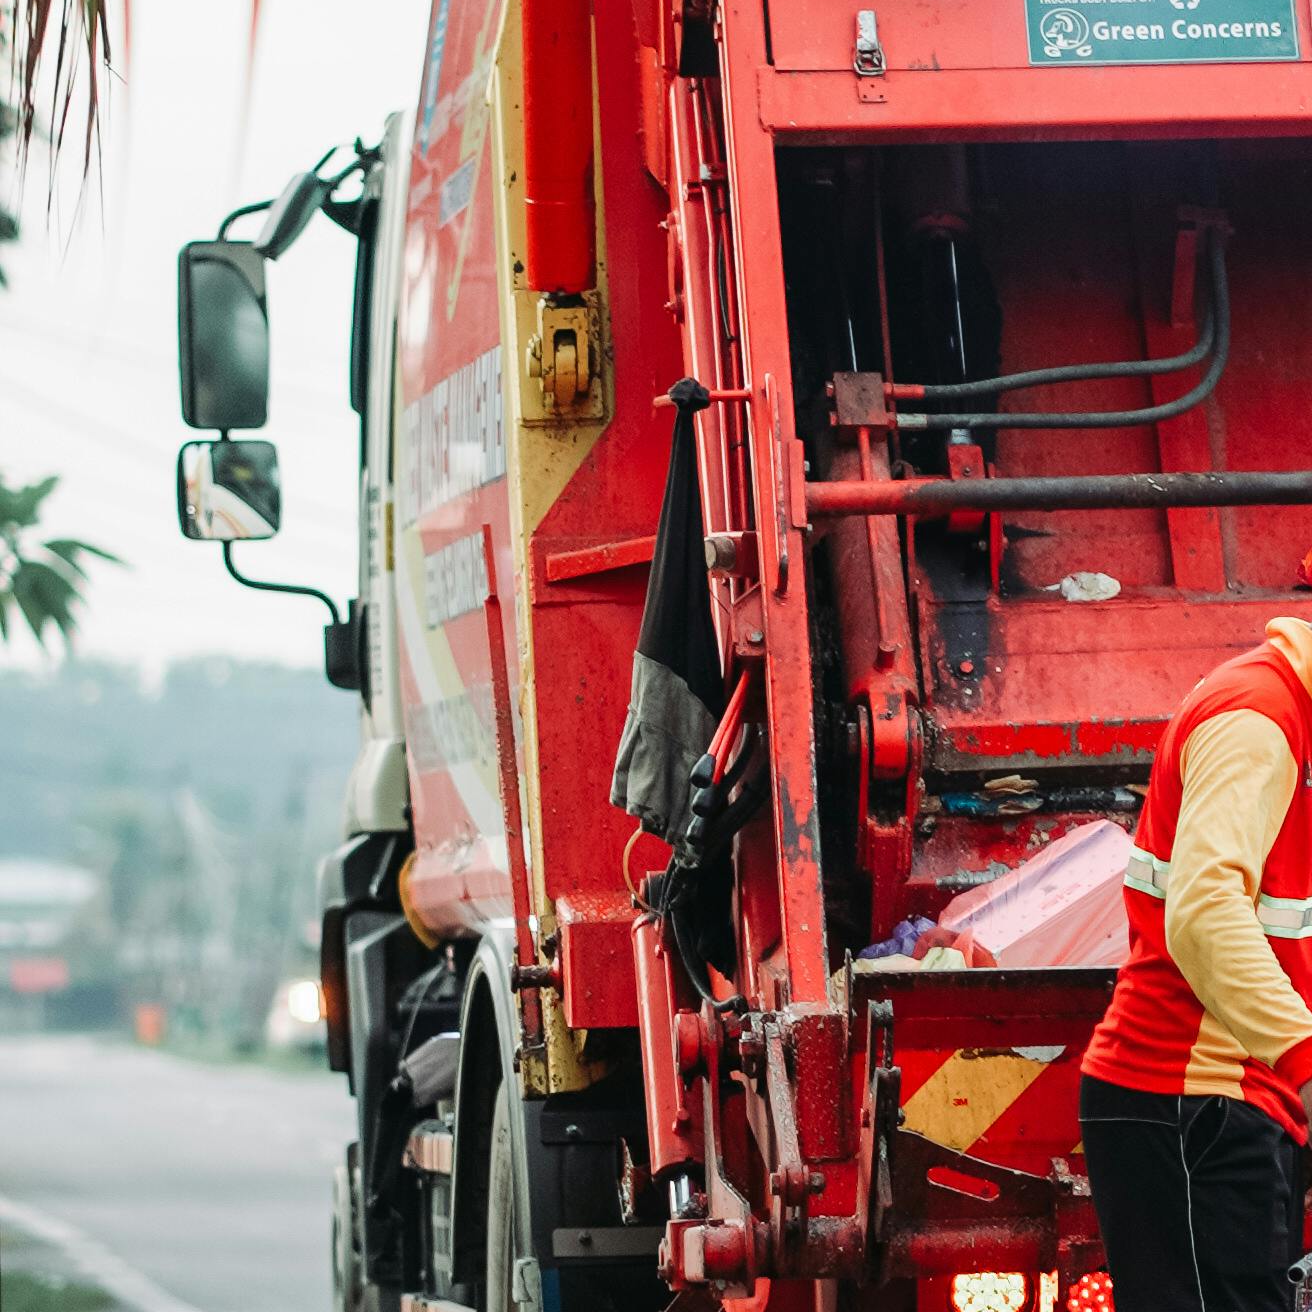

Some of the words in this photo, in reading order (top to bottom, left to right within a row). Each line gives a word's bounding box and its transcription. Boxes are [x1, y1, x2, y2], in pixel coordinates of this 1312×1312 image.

[1092, 20, 1165, 41] Green
[1170, 19, 1282, 39] Concerns
[952, 1098, 968, 1106] 3M
